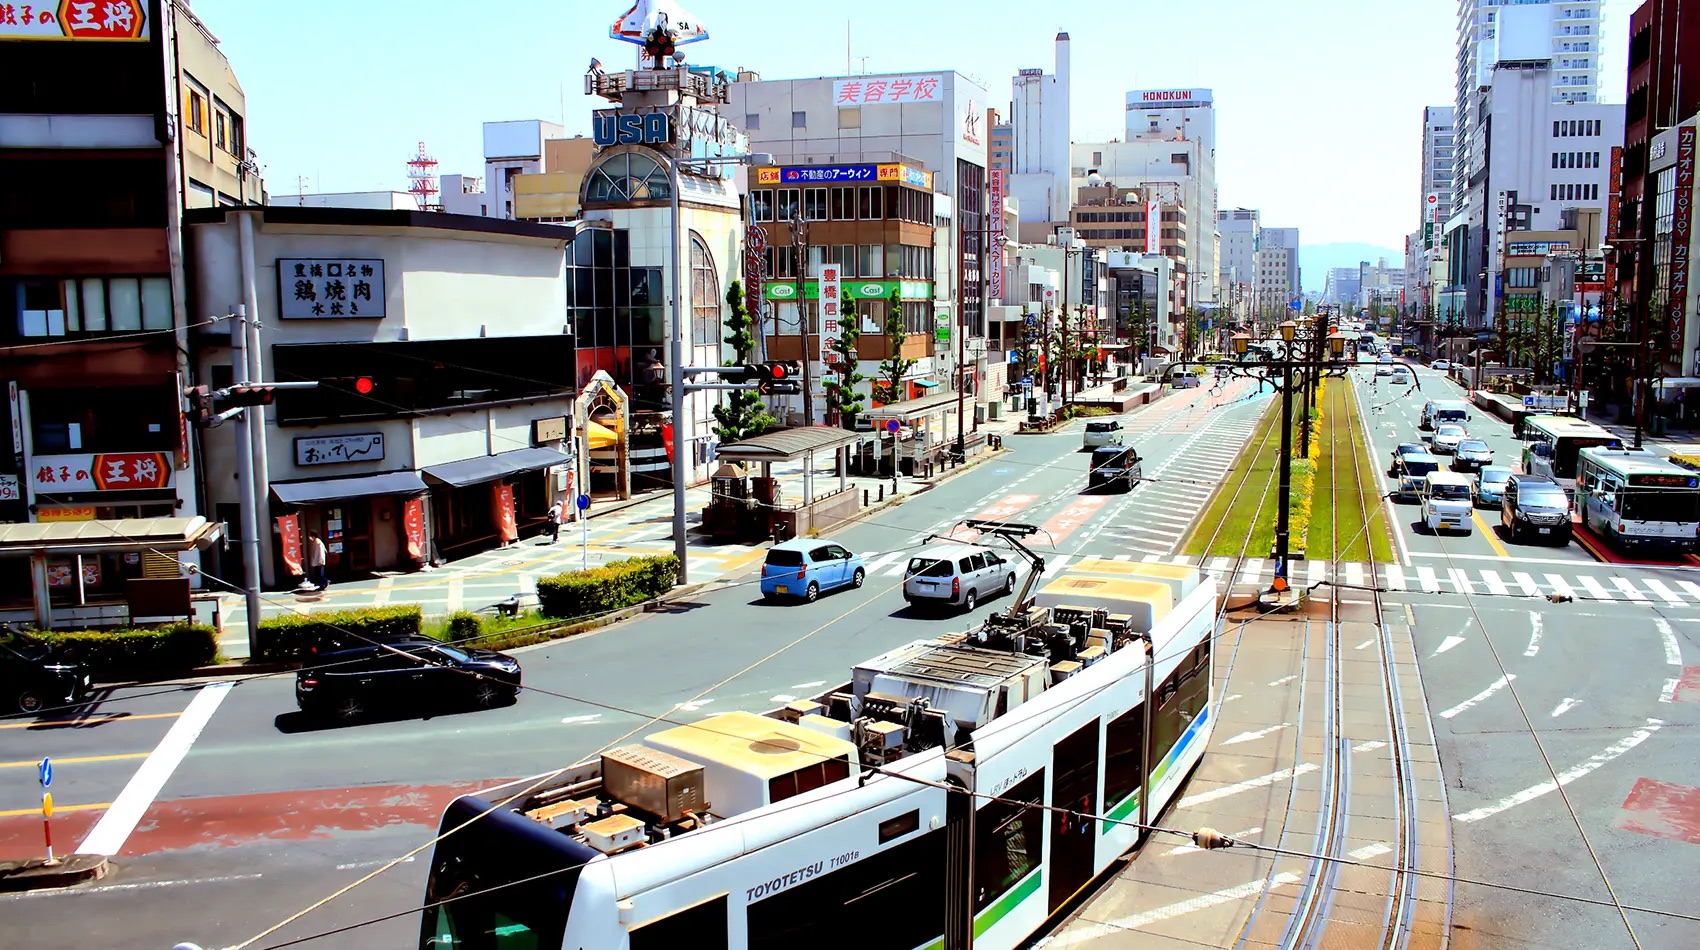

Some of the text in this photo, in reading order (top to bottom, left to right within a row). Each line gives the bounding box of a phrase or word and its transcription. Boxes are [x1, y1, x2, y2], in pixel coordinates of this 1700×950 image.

[677, 22, 690, 31] SA
[838, 78, 939, 103] 美容学校
[1143, 91, 1192, 101] HONOKUNI
[594, 112, 669, 146] USA
[760, 171, 779, 181] 店舗
[801, 168, 871, 180] 不動産のアーウィン
[880, 167, 899, 178] 専門
[1677, 131, 1694, 237] カラオケ JOYJOY
[992, 172, 1000, 214] 美容専門学校
[295, 263, 373, 278] 豊橋 名物
[1673, 243, 1687, 294] カラオケ
[294, 280, 371, 301] 鶏焼肉
[774, 287, 791, 295] Cast
[863, 286, 881, 294] Cast
[312, 302, 358, 316] 水炊き
[36, 457, 157, 482] 餃子の王将
[746, 860, 824, 901] TOYOTETSU
